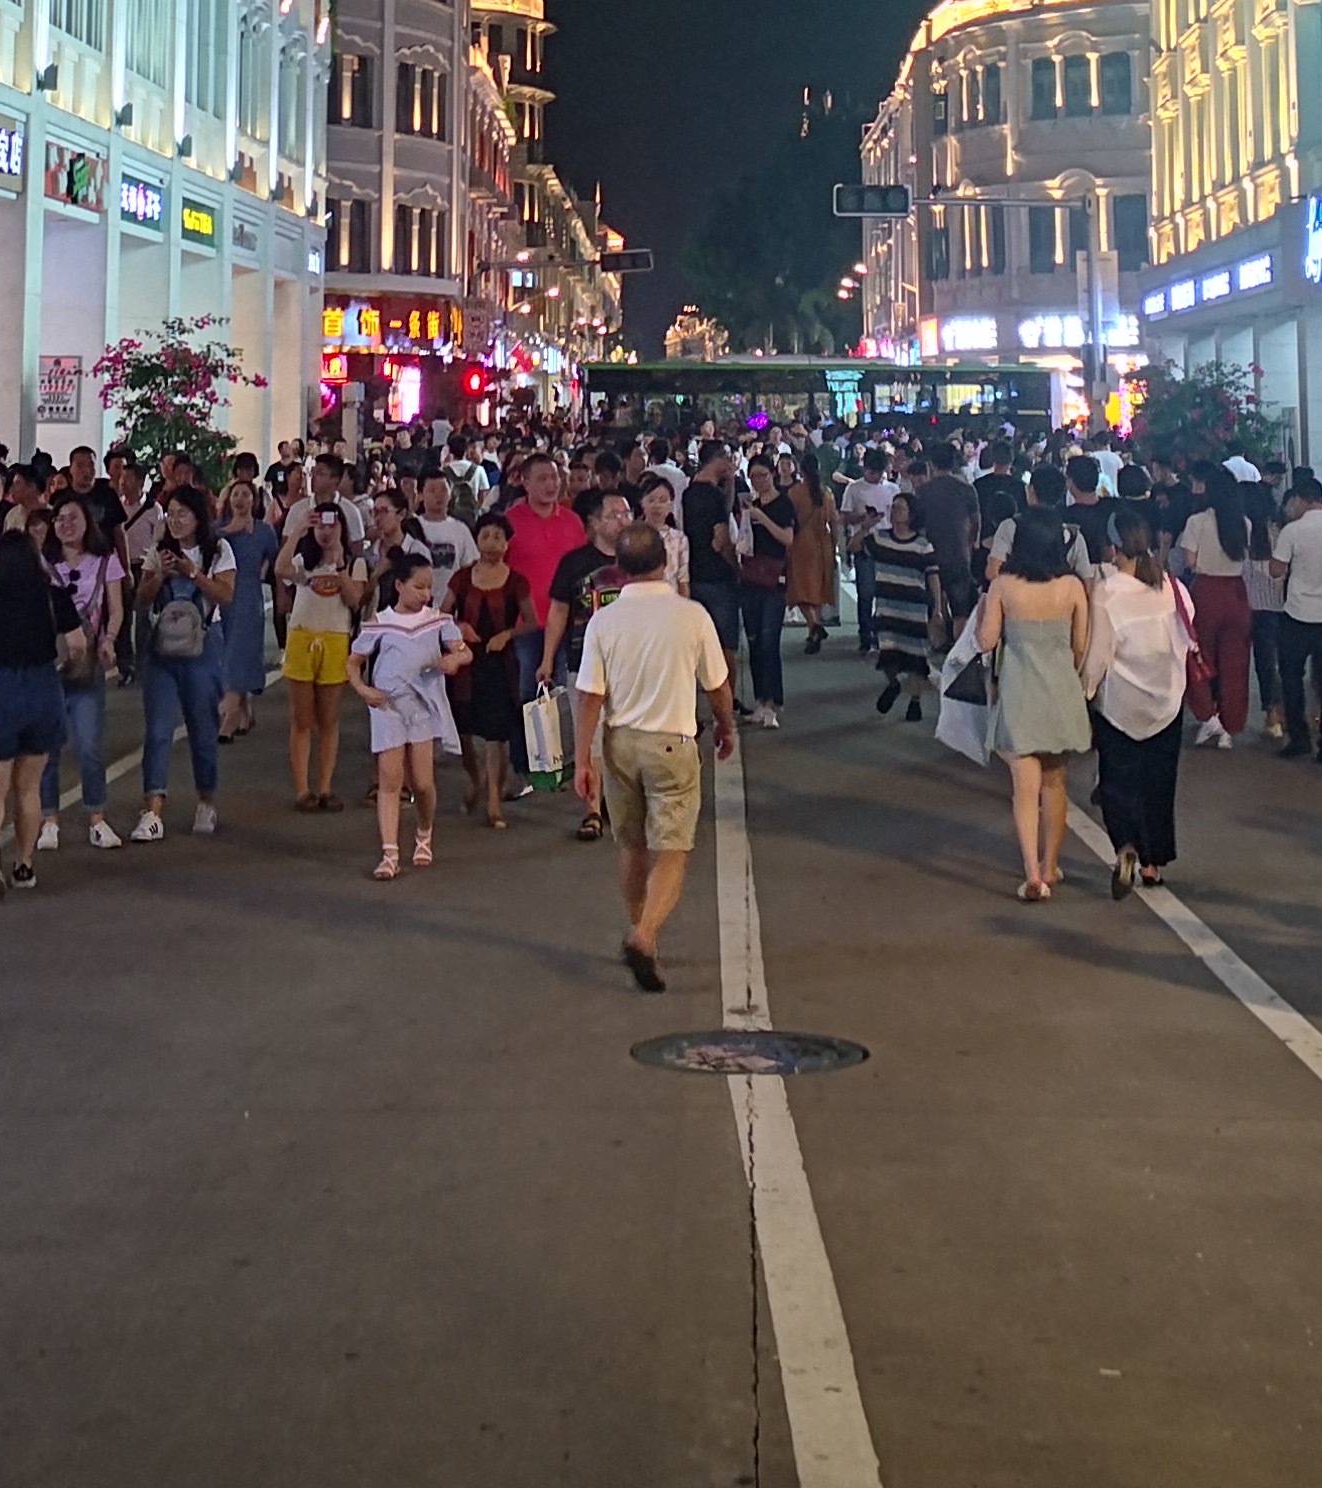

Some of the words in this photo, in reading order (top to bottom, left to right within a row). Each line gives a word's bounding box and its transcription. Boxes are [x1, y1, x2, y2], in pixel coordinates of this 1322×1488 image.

[322, 307, 441, 340] 首饰一条街
